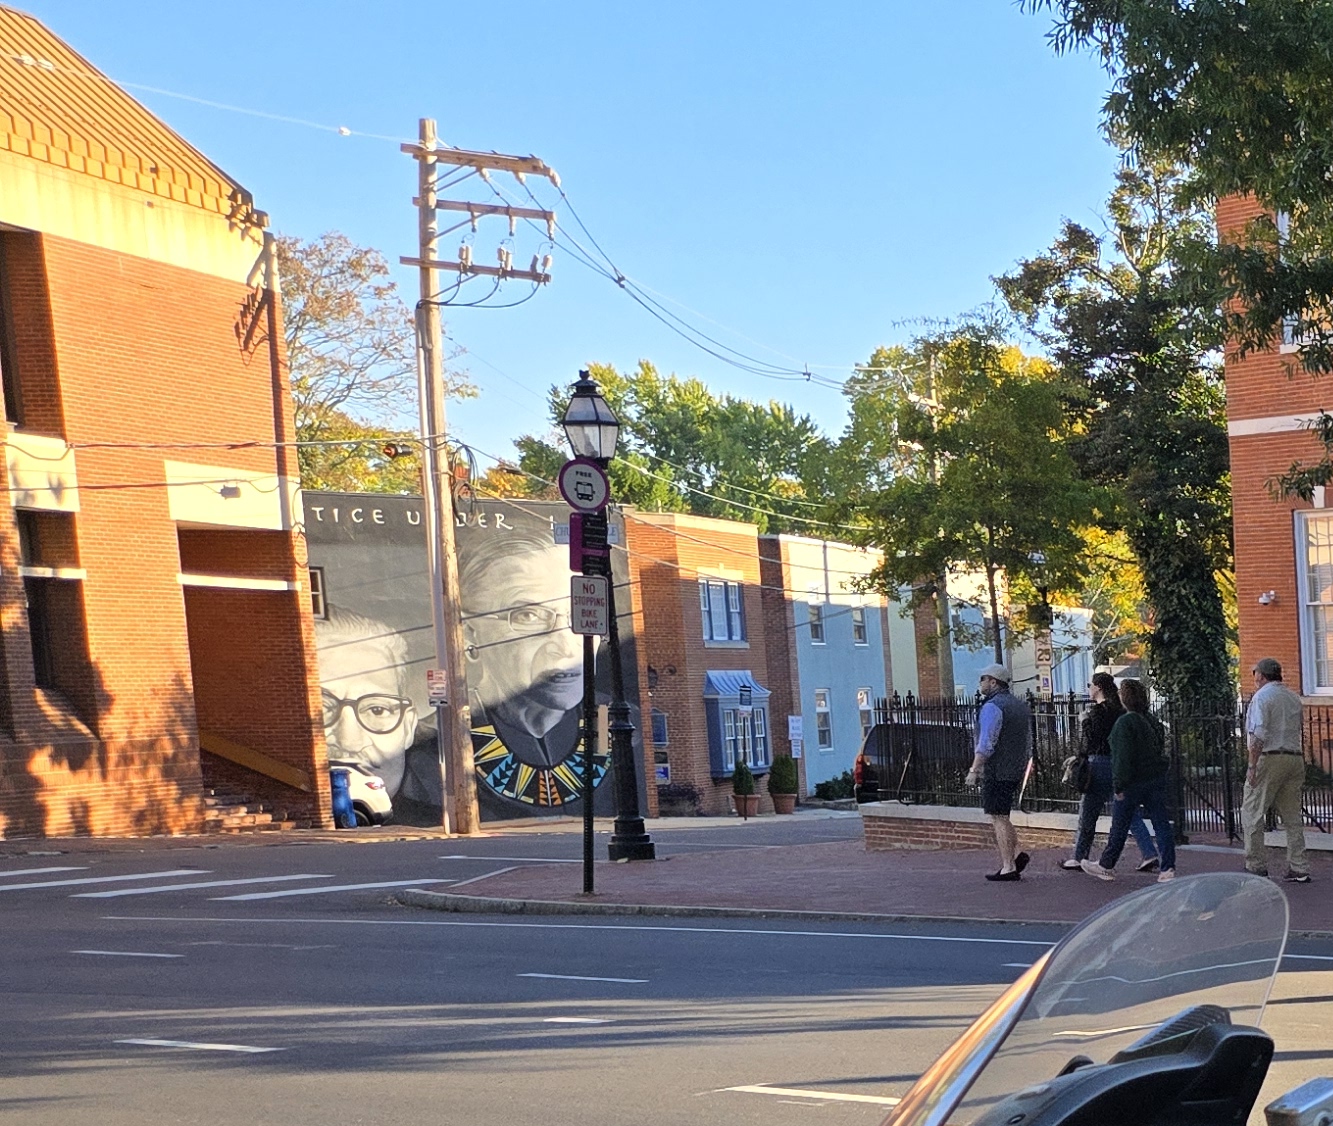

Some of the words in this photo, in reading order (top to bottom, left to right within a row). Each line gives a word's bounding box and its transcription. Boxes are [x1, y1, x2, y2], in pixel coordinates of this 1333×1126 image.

[575, 470, 592, 478] FREE
[407, 511, 514, 530] UDER
[582, 583, 596, 594] NO
[574, 595, 605, 607] STOPPING
[581, 608, 598, 619] BIKE
[580, 619, 599, 630] LANE
[1037, 648, 1051, 662] 25
